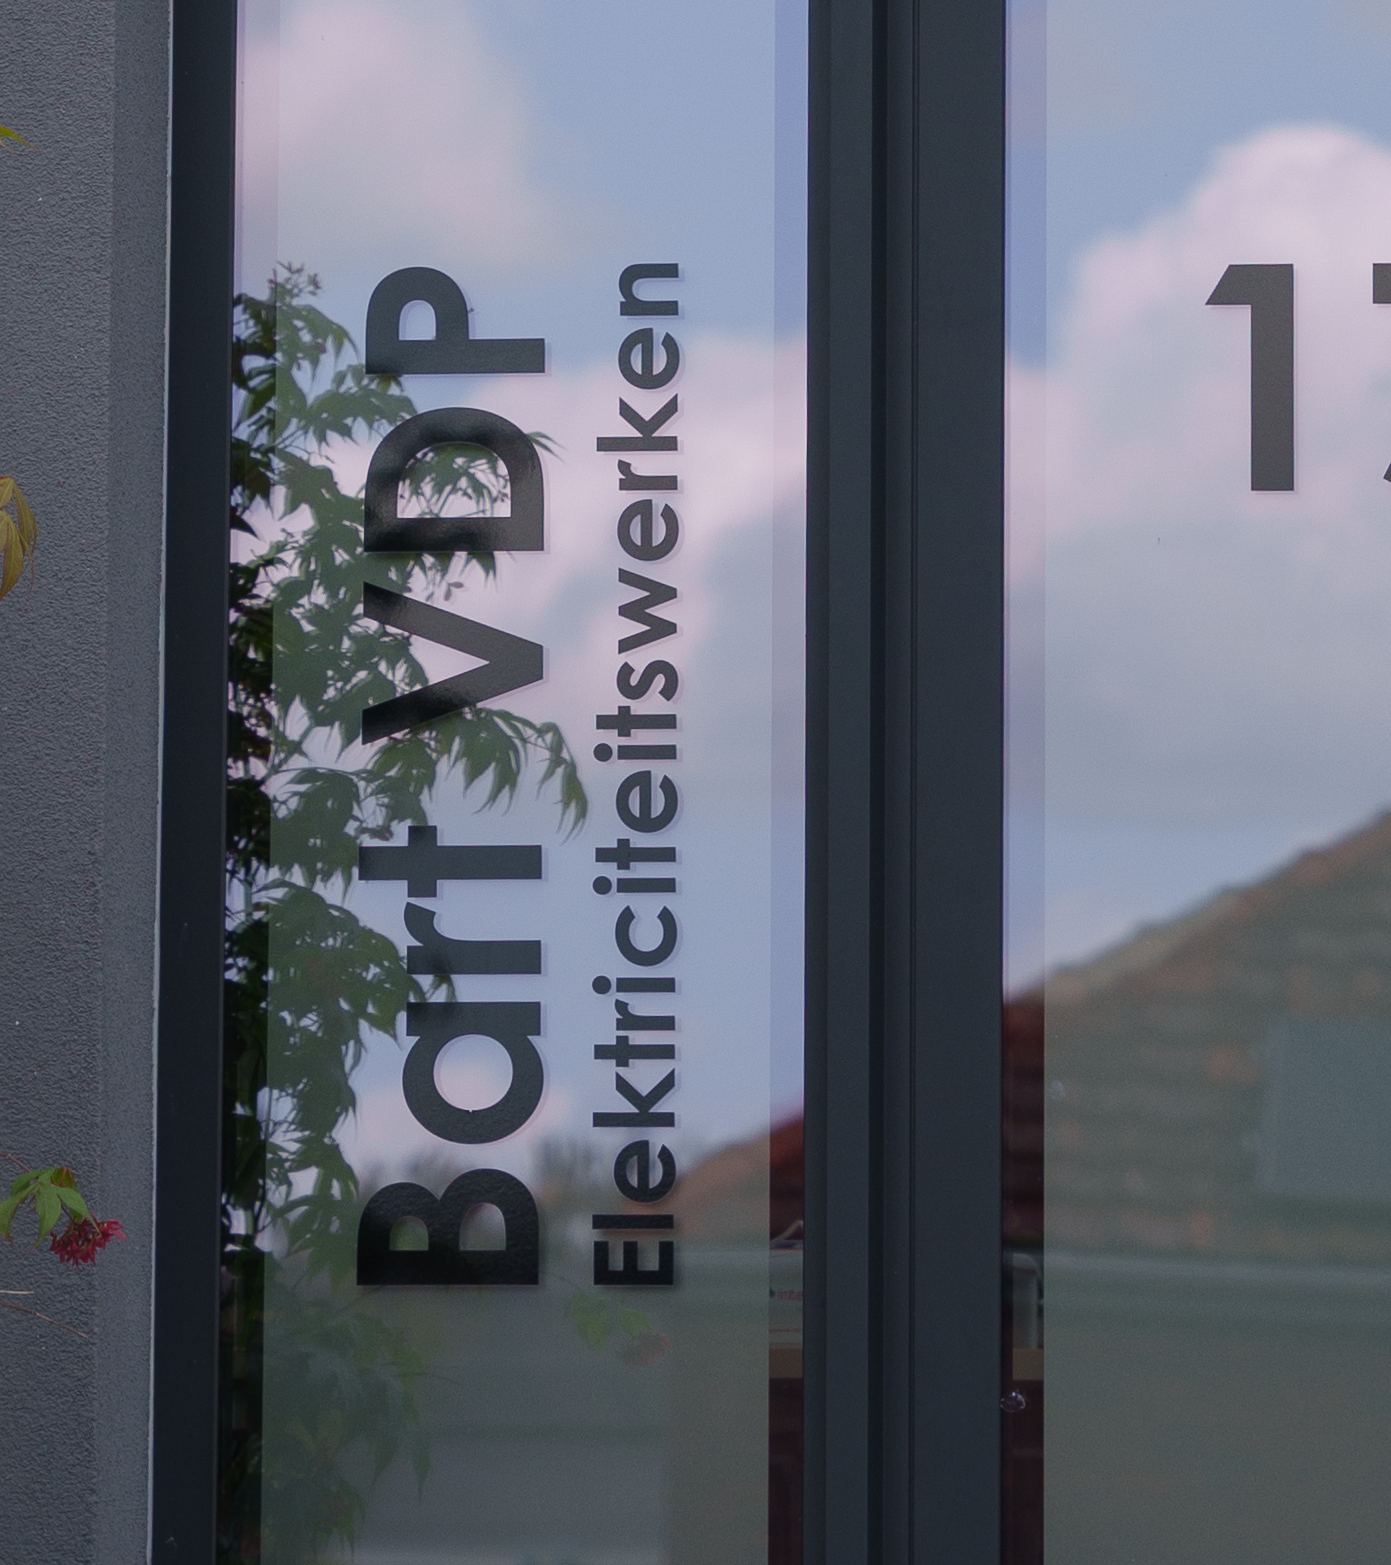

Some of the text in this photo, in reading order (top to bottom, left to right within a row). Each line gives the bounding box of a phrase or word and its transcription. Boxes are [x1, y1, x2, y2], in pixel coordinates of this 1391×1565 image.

[357, 266, 545, 1285] Bart VDP
[591, 262, 679, 1285] Elektriciteitswerken
